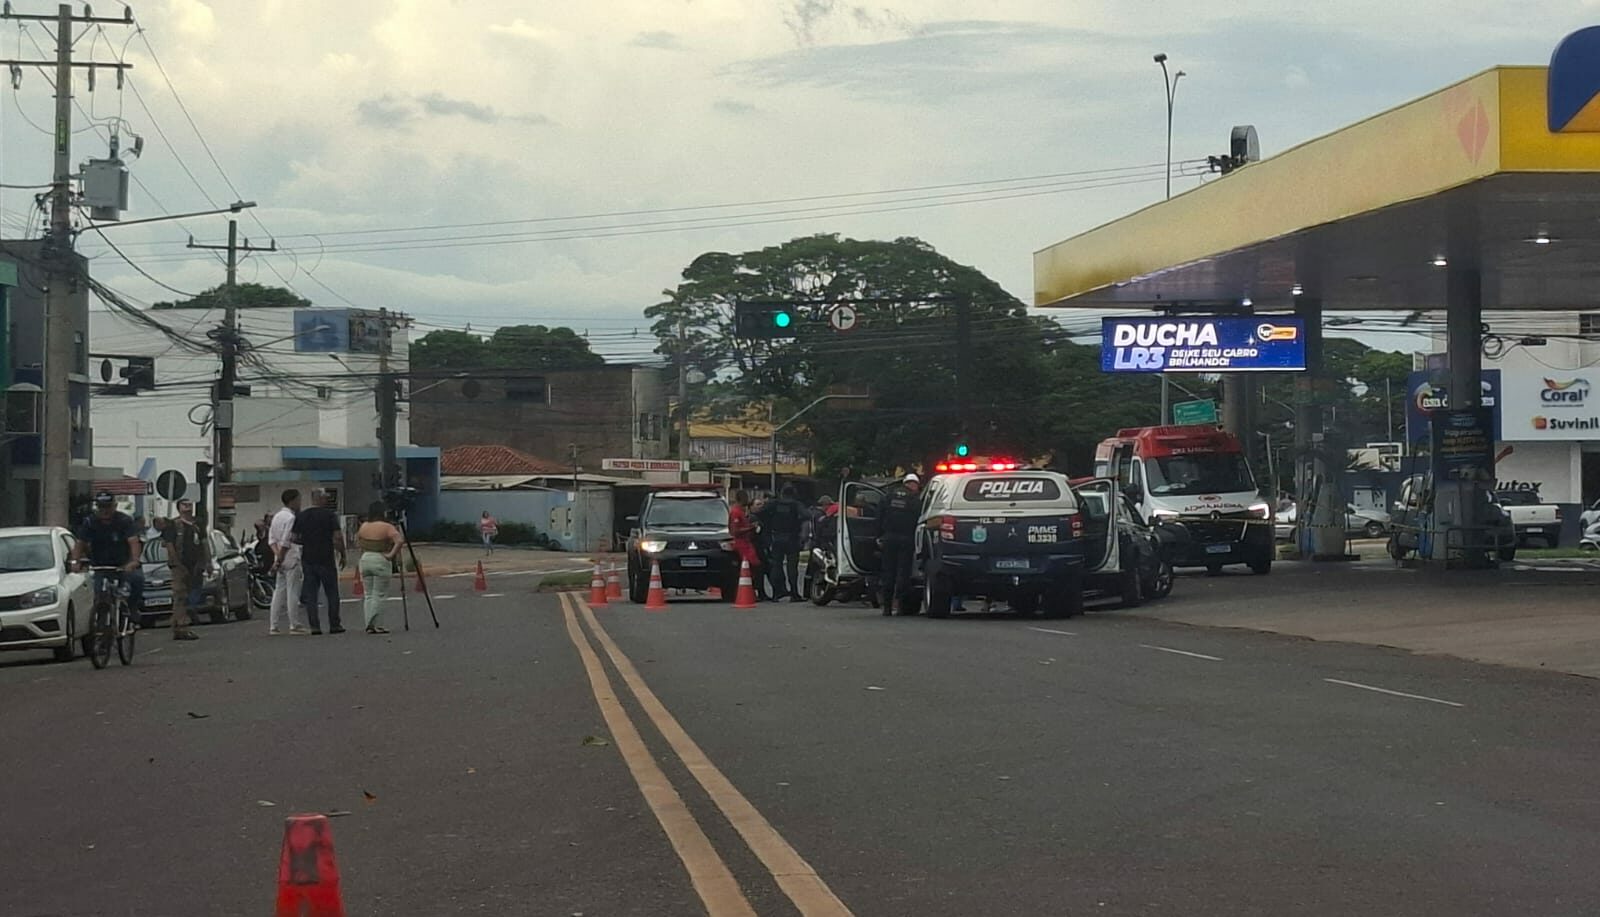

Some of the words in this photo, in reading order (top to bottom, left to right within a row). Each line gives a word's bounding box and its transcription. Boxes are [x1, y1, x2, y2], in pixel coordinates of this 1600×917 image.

[1114, 323, 1218, 346] DUCHA
[1114, 347, 1165, 369] LR3
[1171, 349, 1200, 357] DEIXE
[1202, 349, 1221, 357] SEU
[1223, 348, 1258, 357] CARRO
[1540, 388, 1583, 402] Coral
[1550, 416, 1600, 430] Suvinil
